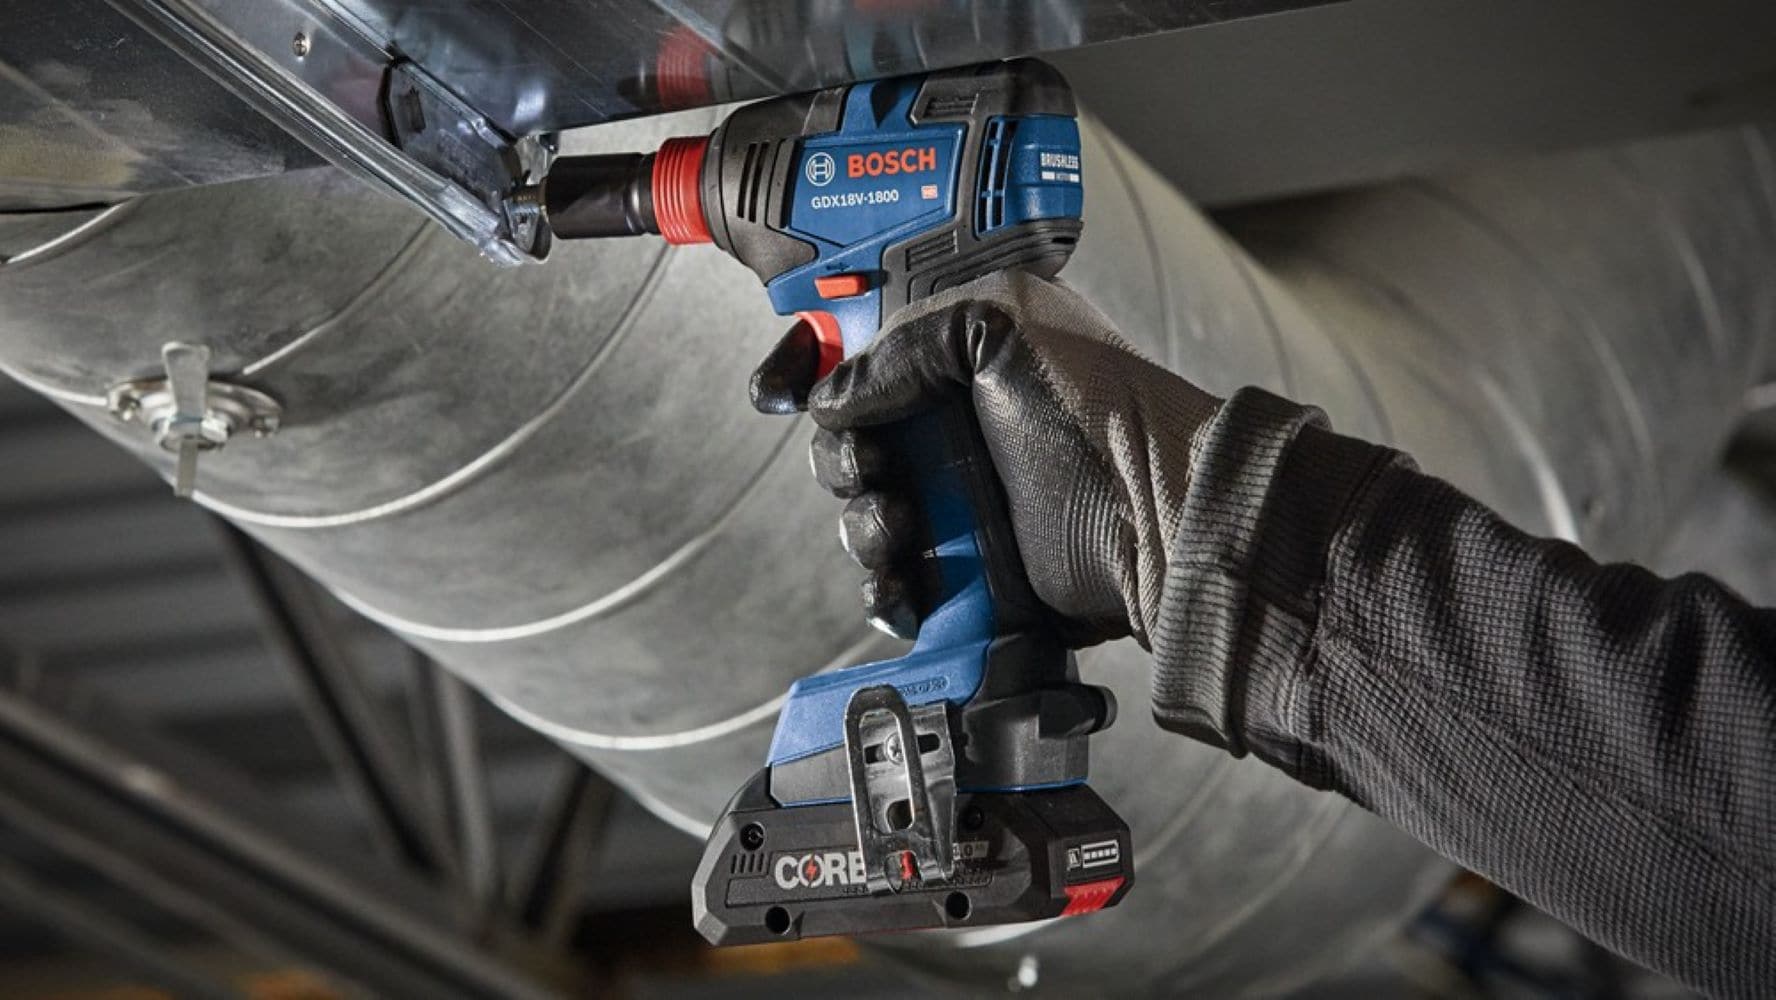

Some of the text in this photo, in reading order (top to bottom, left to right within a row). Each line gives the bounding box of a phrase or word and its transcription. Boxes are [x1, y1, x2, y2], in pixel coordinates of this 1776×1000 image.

[847, 147, 937, 178] BOSCH
[811, 189, 900, 210] GDX18V-1800
[775, 851, 867, 890] CORE
